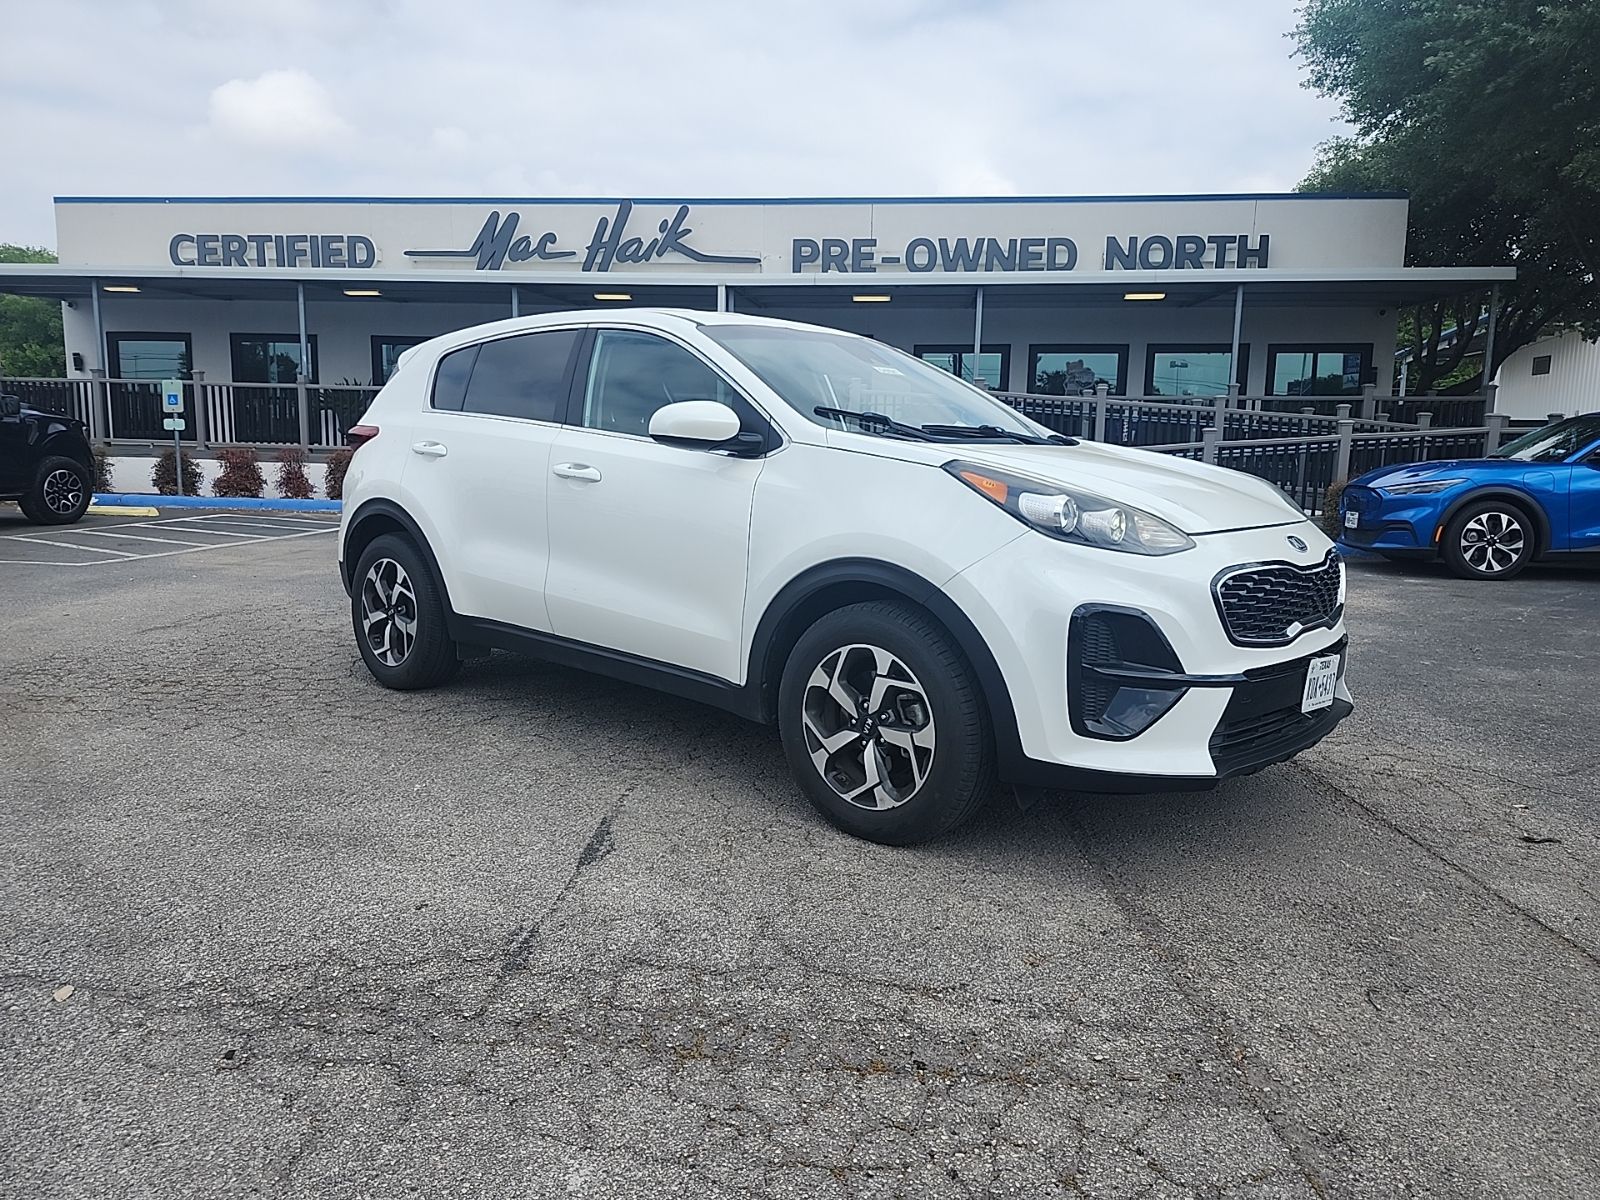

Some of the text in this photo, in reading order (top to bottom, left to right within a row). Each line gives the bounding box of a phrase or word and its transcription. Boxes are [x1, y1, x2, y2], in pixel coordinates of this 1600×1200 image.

[169, 200, 1270, 273] CERTIFIED Mac Haik PRE-OWNED NORTH
[863, 718, 873, 734] KIA
